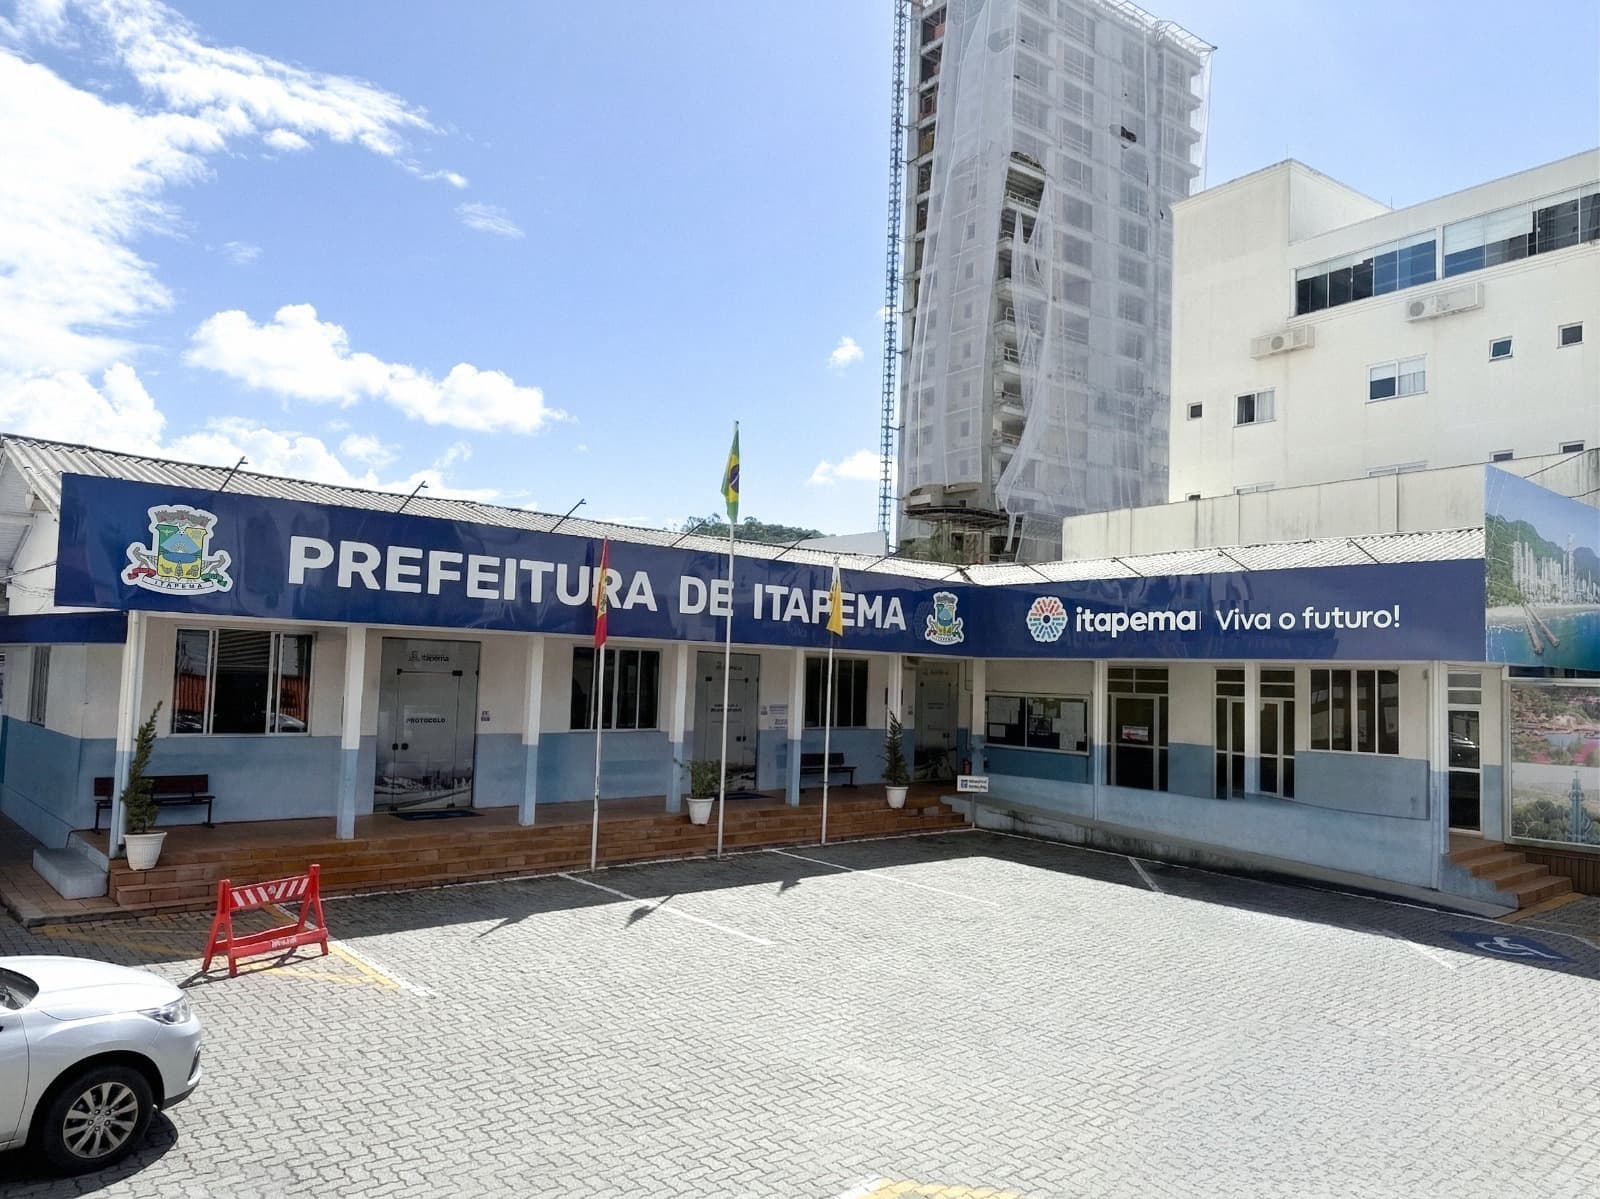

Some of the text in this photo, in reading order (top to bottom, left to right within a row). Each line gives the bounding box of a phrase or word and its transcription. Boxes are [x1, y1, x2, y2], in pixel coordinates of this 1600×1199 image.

[154, 580, 203, 590] ITAPEMA
[288, 535, 907, 631] PREFEITURA DE ITAPEMA
[1075, 605, 1401, 638] itapema Viva o futuro!
[405, 716, 446, 724] PROTOCOLO
